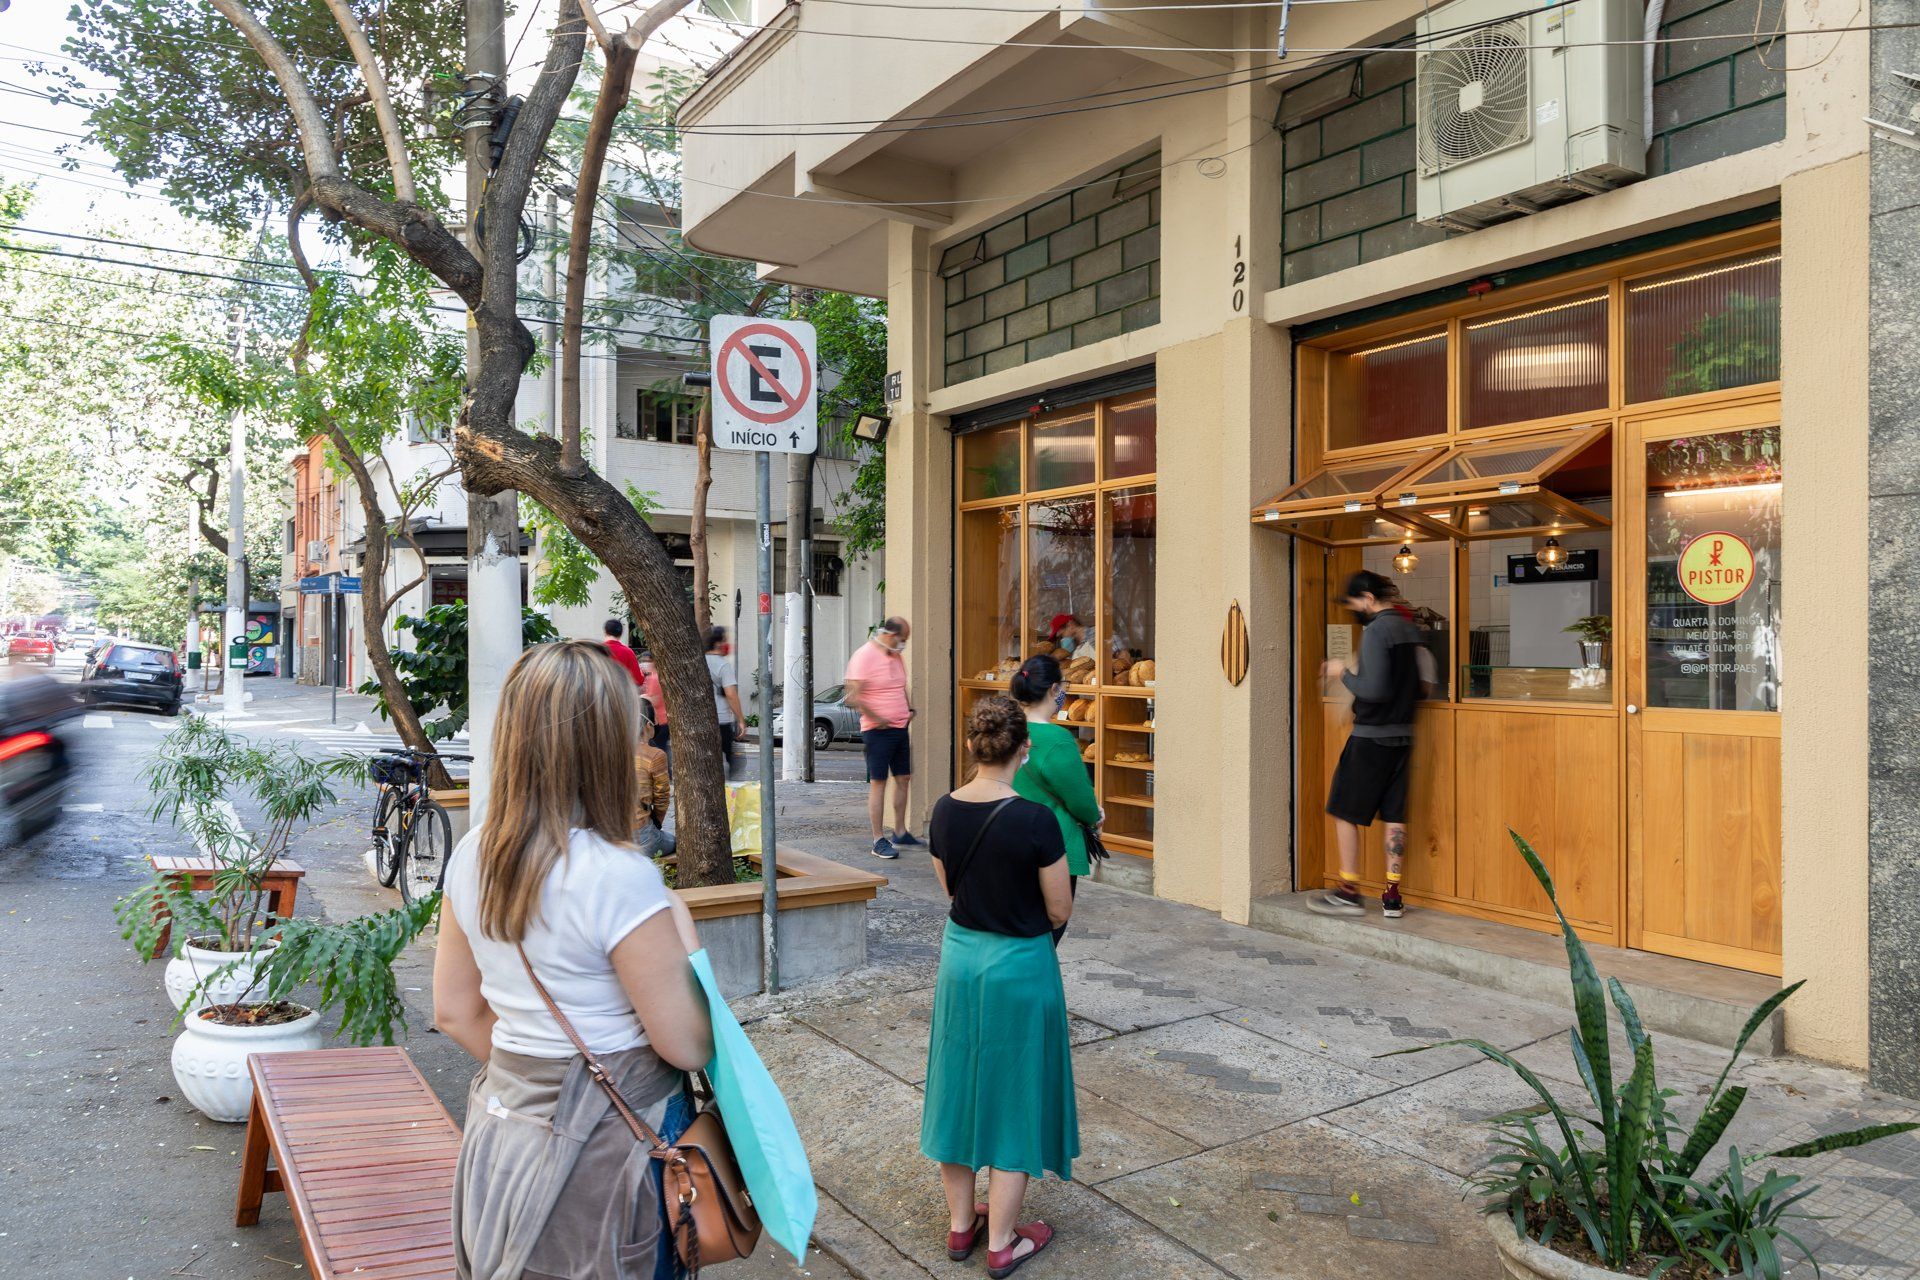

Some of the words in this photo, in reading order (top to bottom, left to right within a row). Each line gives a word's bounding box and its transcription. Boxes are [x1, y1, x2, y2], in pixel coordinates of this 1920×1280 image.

[1232, 234, 1245, 312] 120
[749, 345, 782, 403] E
[731, 428, 777, 446] INÍCIO
[1689, 568, 1744, 585] PISTOR
[1673, 617, 1708, 627] QUARTA
[1686, 631, 1709, 640] MEIO
[1688, 643, 1702, 652] ATÉ
[1704, 644, 1711, 652] O
[1714, 642, 1743, 652] ÚLTIMO
[1692, 663, 1757, 675] @PISTOR.PAES
